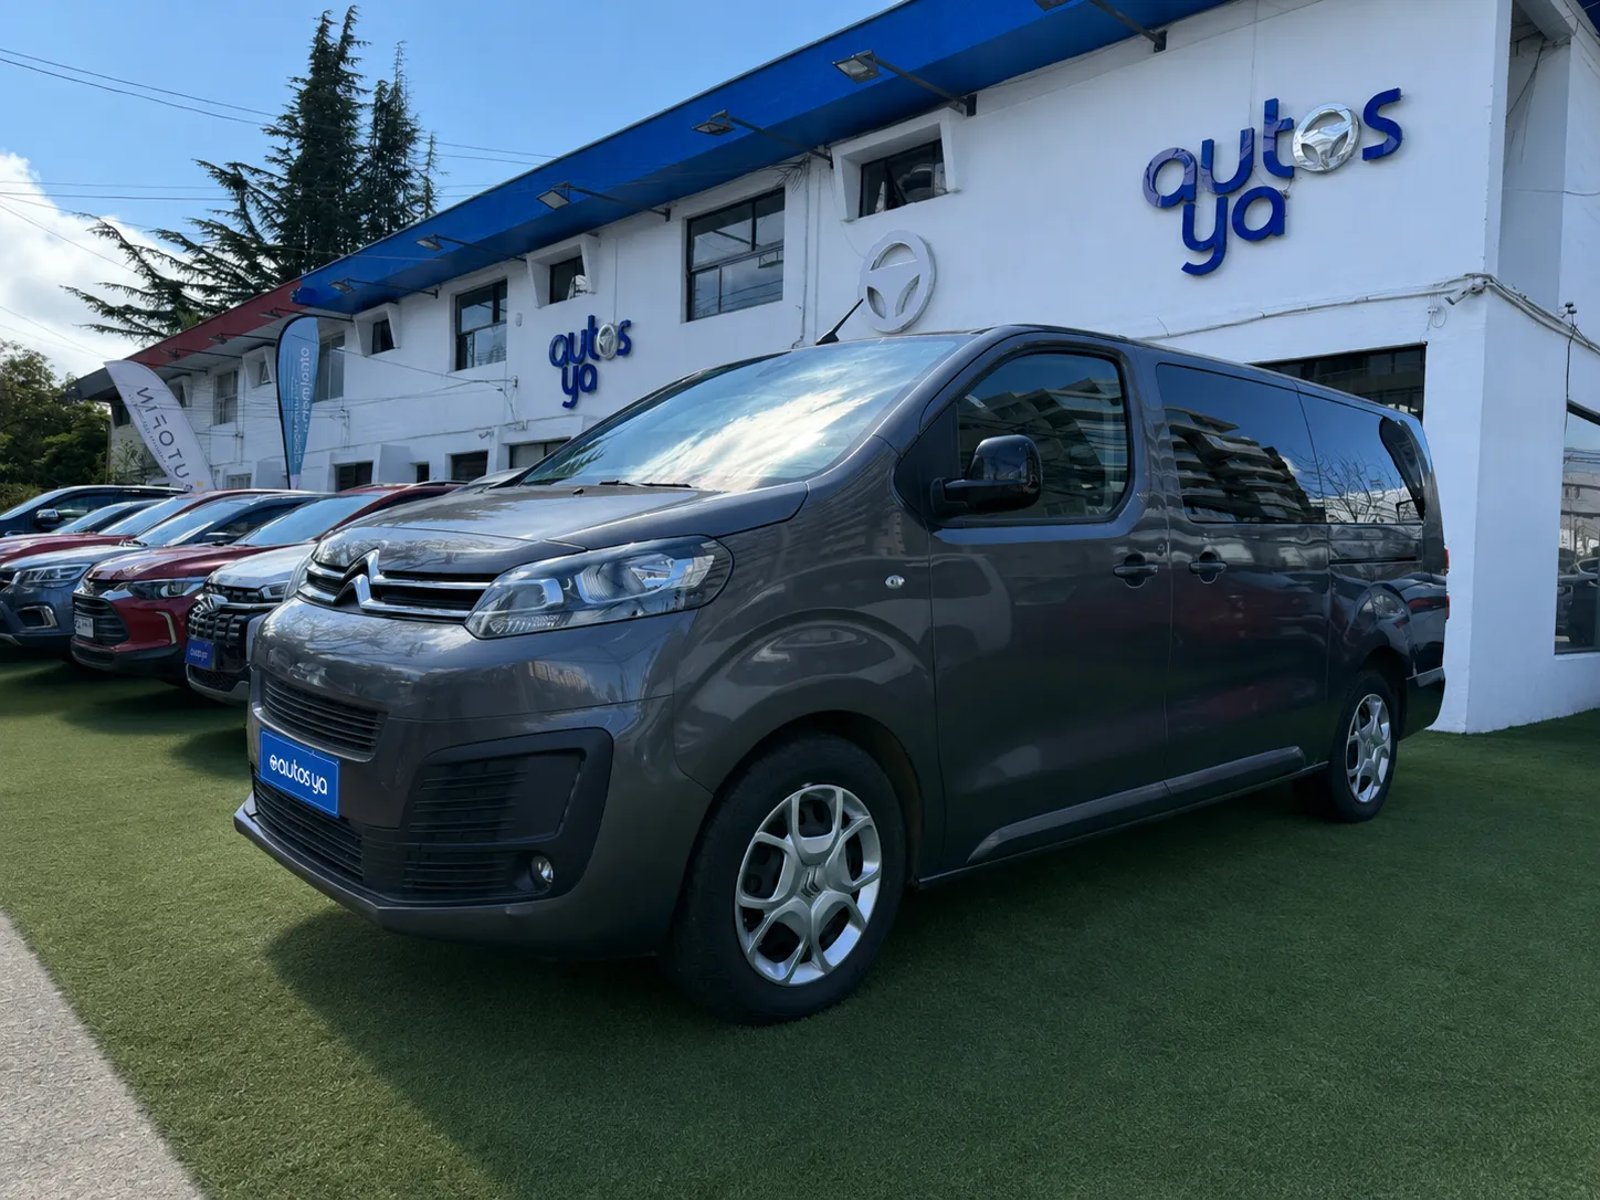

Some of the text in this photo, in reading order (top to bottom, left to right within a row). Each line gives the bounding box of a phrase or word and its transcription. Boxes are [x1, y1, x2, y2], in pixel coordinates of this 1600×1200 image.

[1142, 87, 1403, 209] autos
[1181, 195, 1286, 276] ya
[549, 314, 632, 368] autos
[561, 362, 598, 409] ya
